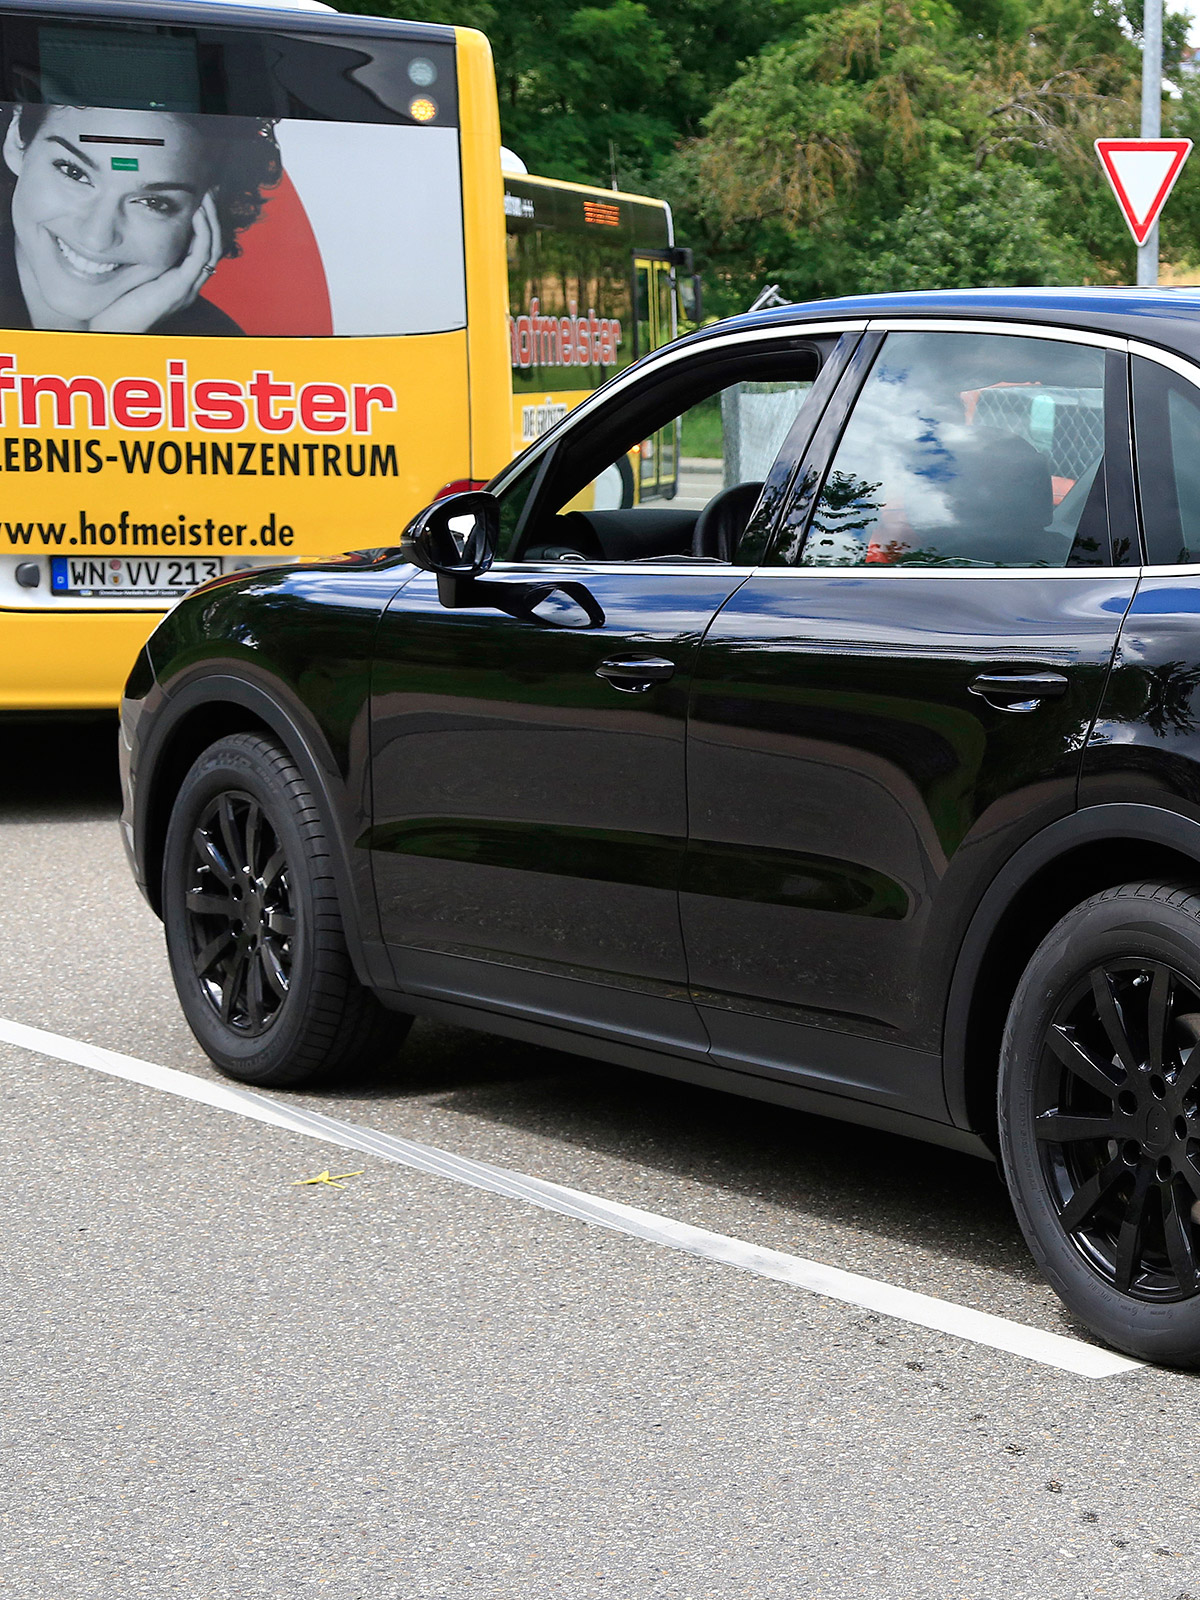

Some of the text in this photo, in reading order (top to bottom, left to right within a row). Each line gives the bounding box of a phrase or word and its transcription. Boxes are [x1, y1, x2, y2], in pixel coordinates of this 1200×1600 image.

[0, 437, 399, 477] EBNIS-WOHNZENTRUM
[0, 510, 294, 547] ww.hofmeister.de
[71, 562, 217, 586] WN VV 213
